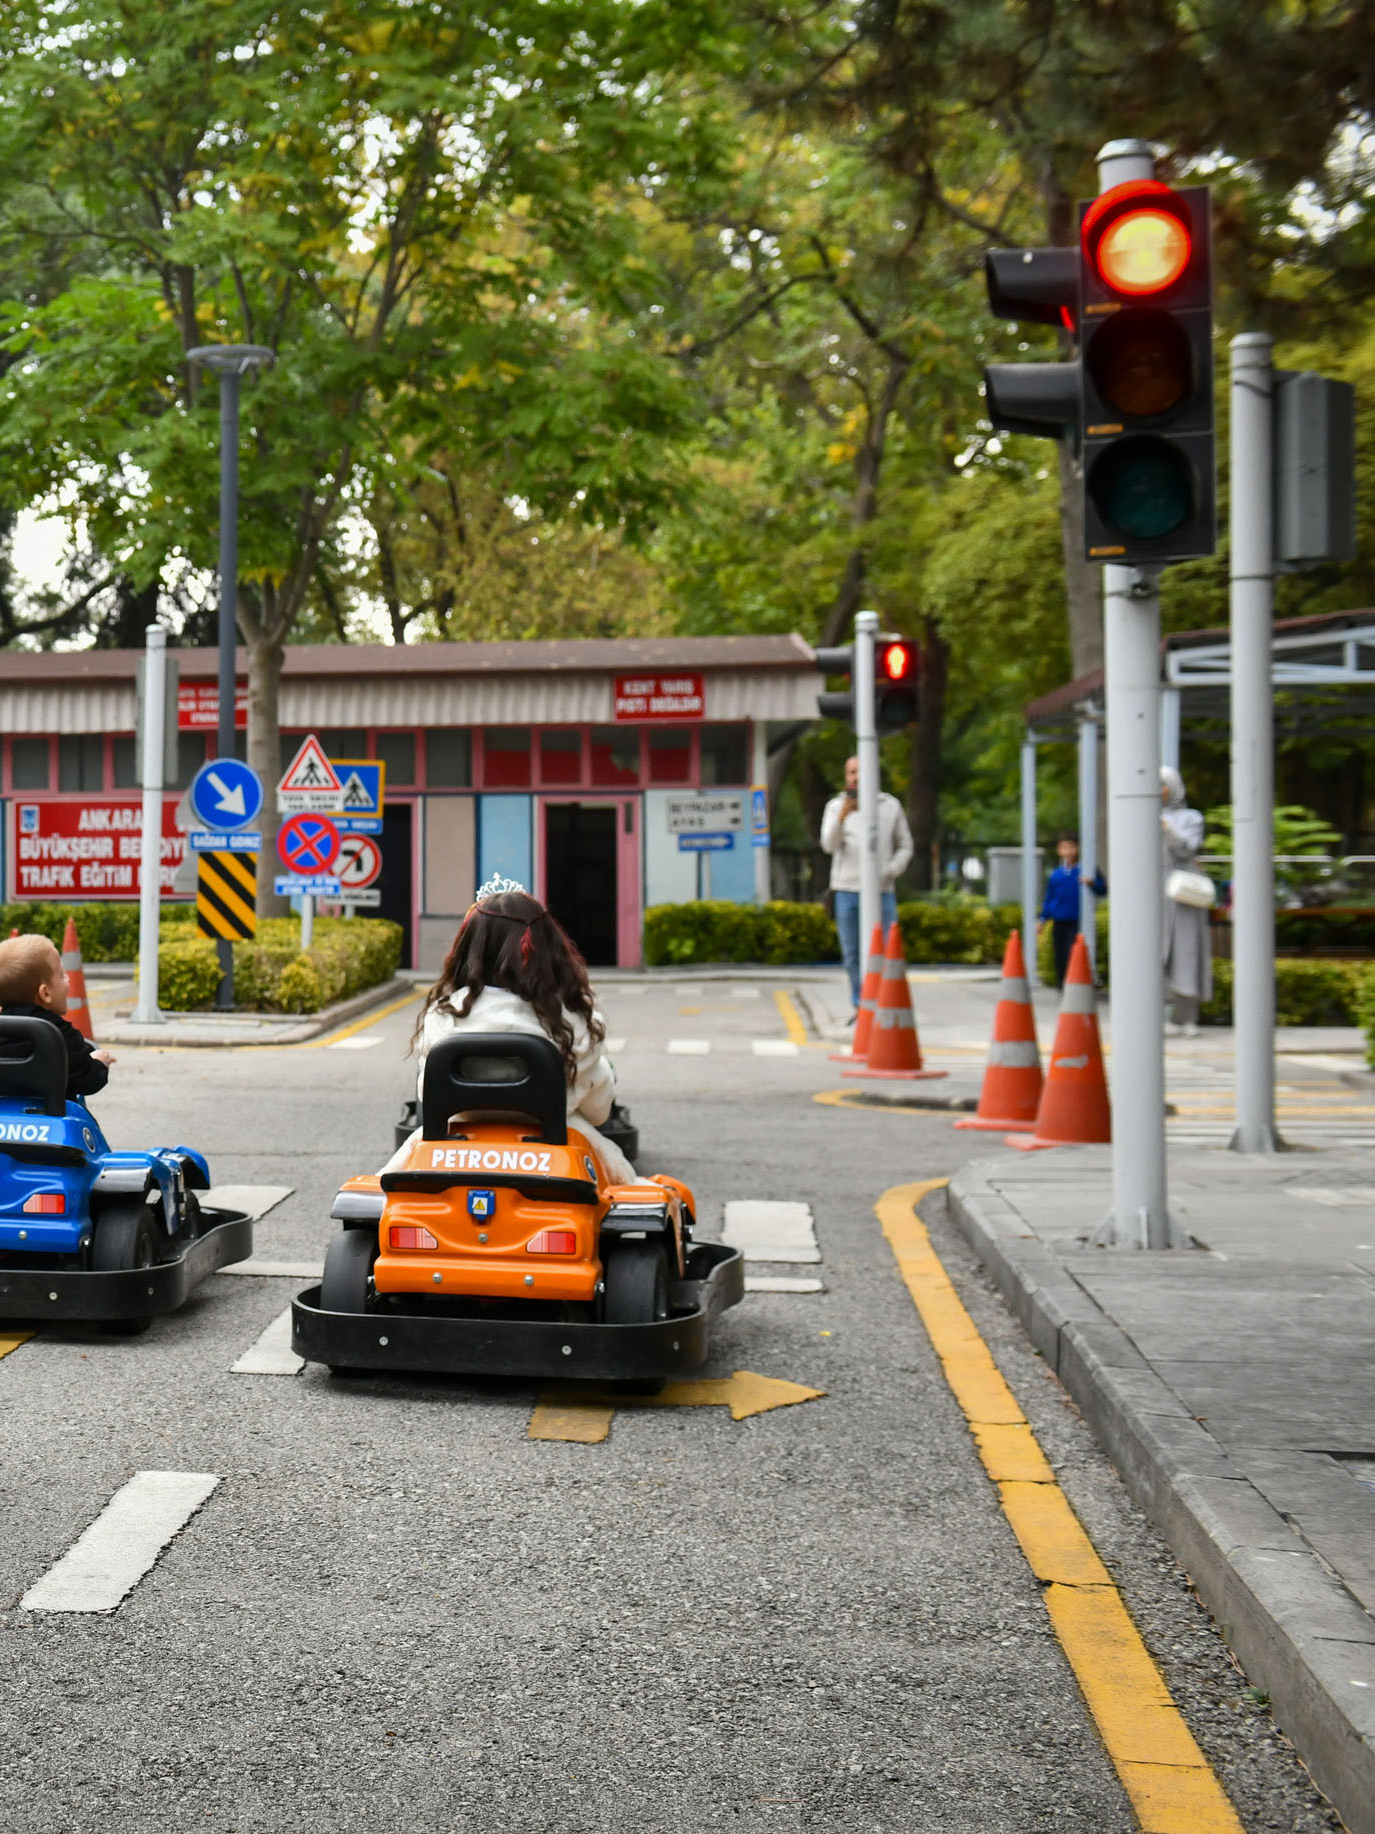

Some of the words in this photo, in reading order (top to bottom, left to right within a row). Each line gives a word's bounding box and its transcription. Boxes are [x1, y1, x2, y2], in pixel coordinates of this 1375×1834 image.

[78, 808, 144, 830] ANKARA
[19, 832, 114, 863] BÜYÜKŞEHİR
[431, 1149, 551, 1172] PETRONOZ
